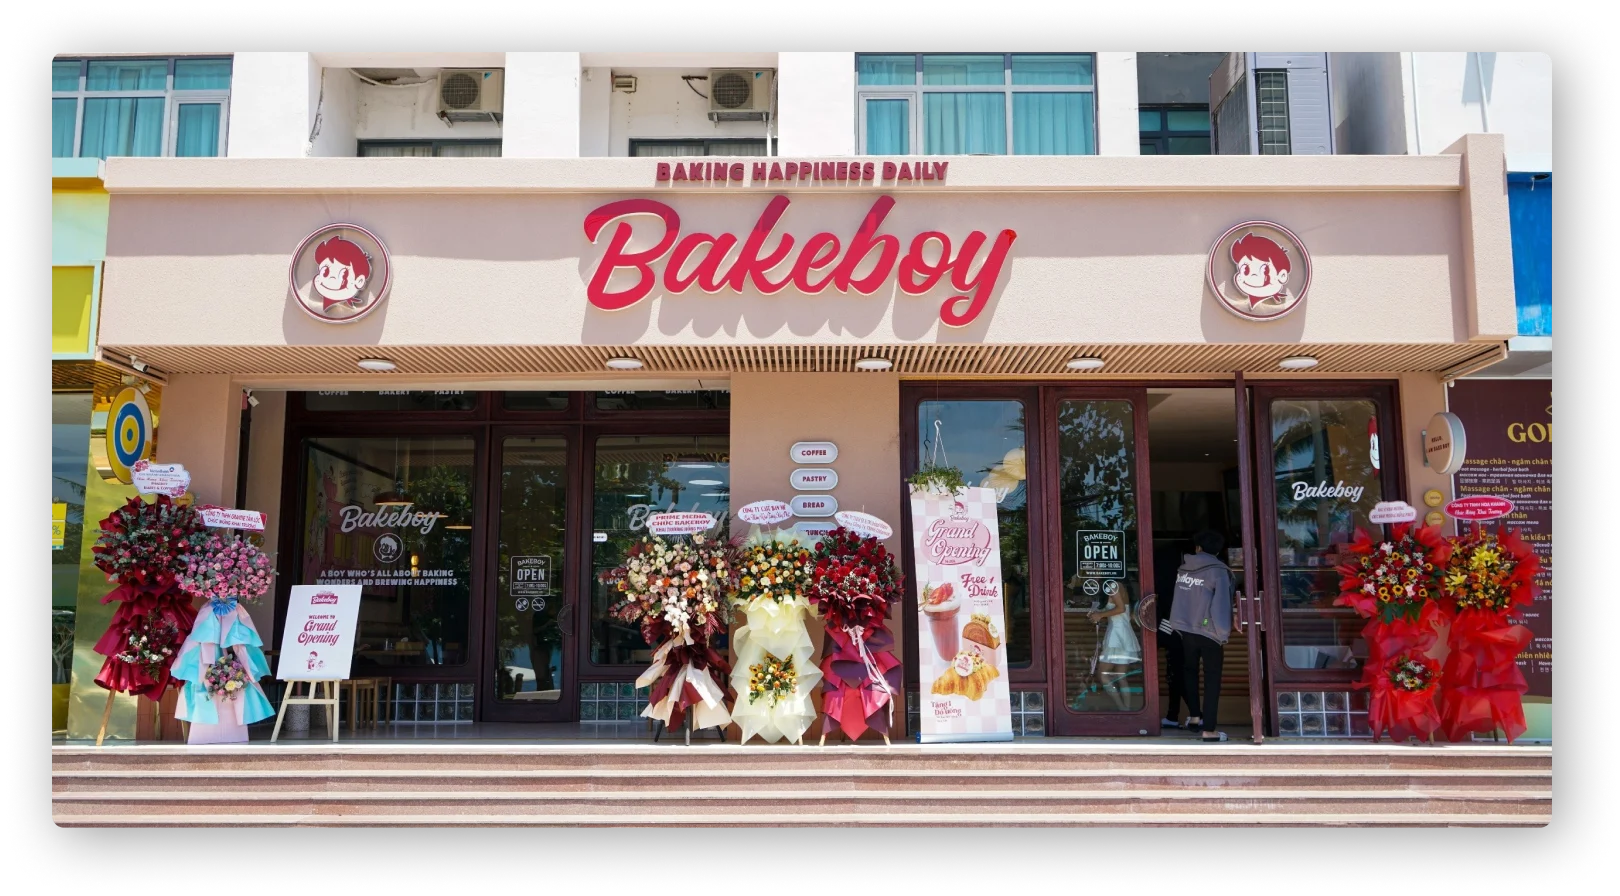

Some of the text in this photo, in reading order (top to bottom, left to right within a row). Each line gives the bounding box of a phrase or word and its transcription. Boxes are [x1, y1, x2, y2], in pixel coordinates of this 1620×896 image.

[656, 161, 949, 181] BAKING HAPPINESS DAILY
[583, 195, 1018, 328] Bakeboy
[1462, 458, 1488, 466] assage
[1291, 480, 1364, 503] Bakeboy
[1460, 485, 1490, 493] Massage
[802, 501, 825, 509] BREAD
[340, 505, 440, 535] Bakeboy
[804, 529, 830, 537] RUNCH
[926, 519, 979, 547] Grand
[1083, 533, 1119, 542] BAKEBOY
[931, 539, 992, 567] Opening
[1084, 545, 1118, 560] OPEN
[517, 558, 546, 566] BAKEBOY
[517, 568, 545, 581] OPEN
[961, 573, 995, 588] Free 1
[968, 584, 999, 598] Drink
[303, 620, 338, 632] Grand
[297, 631, 340, 646] Opening
